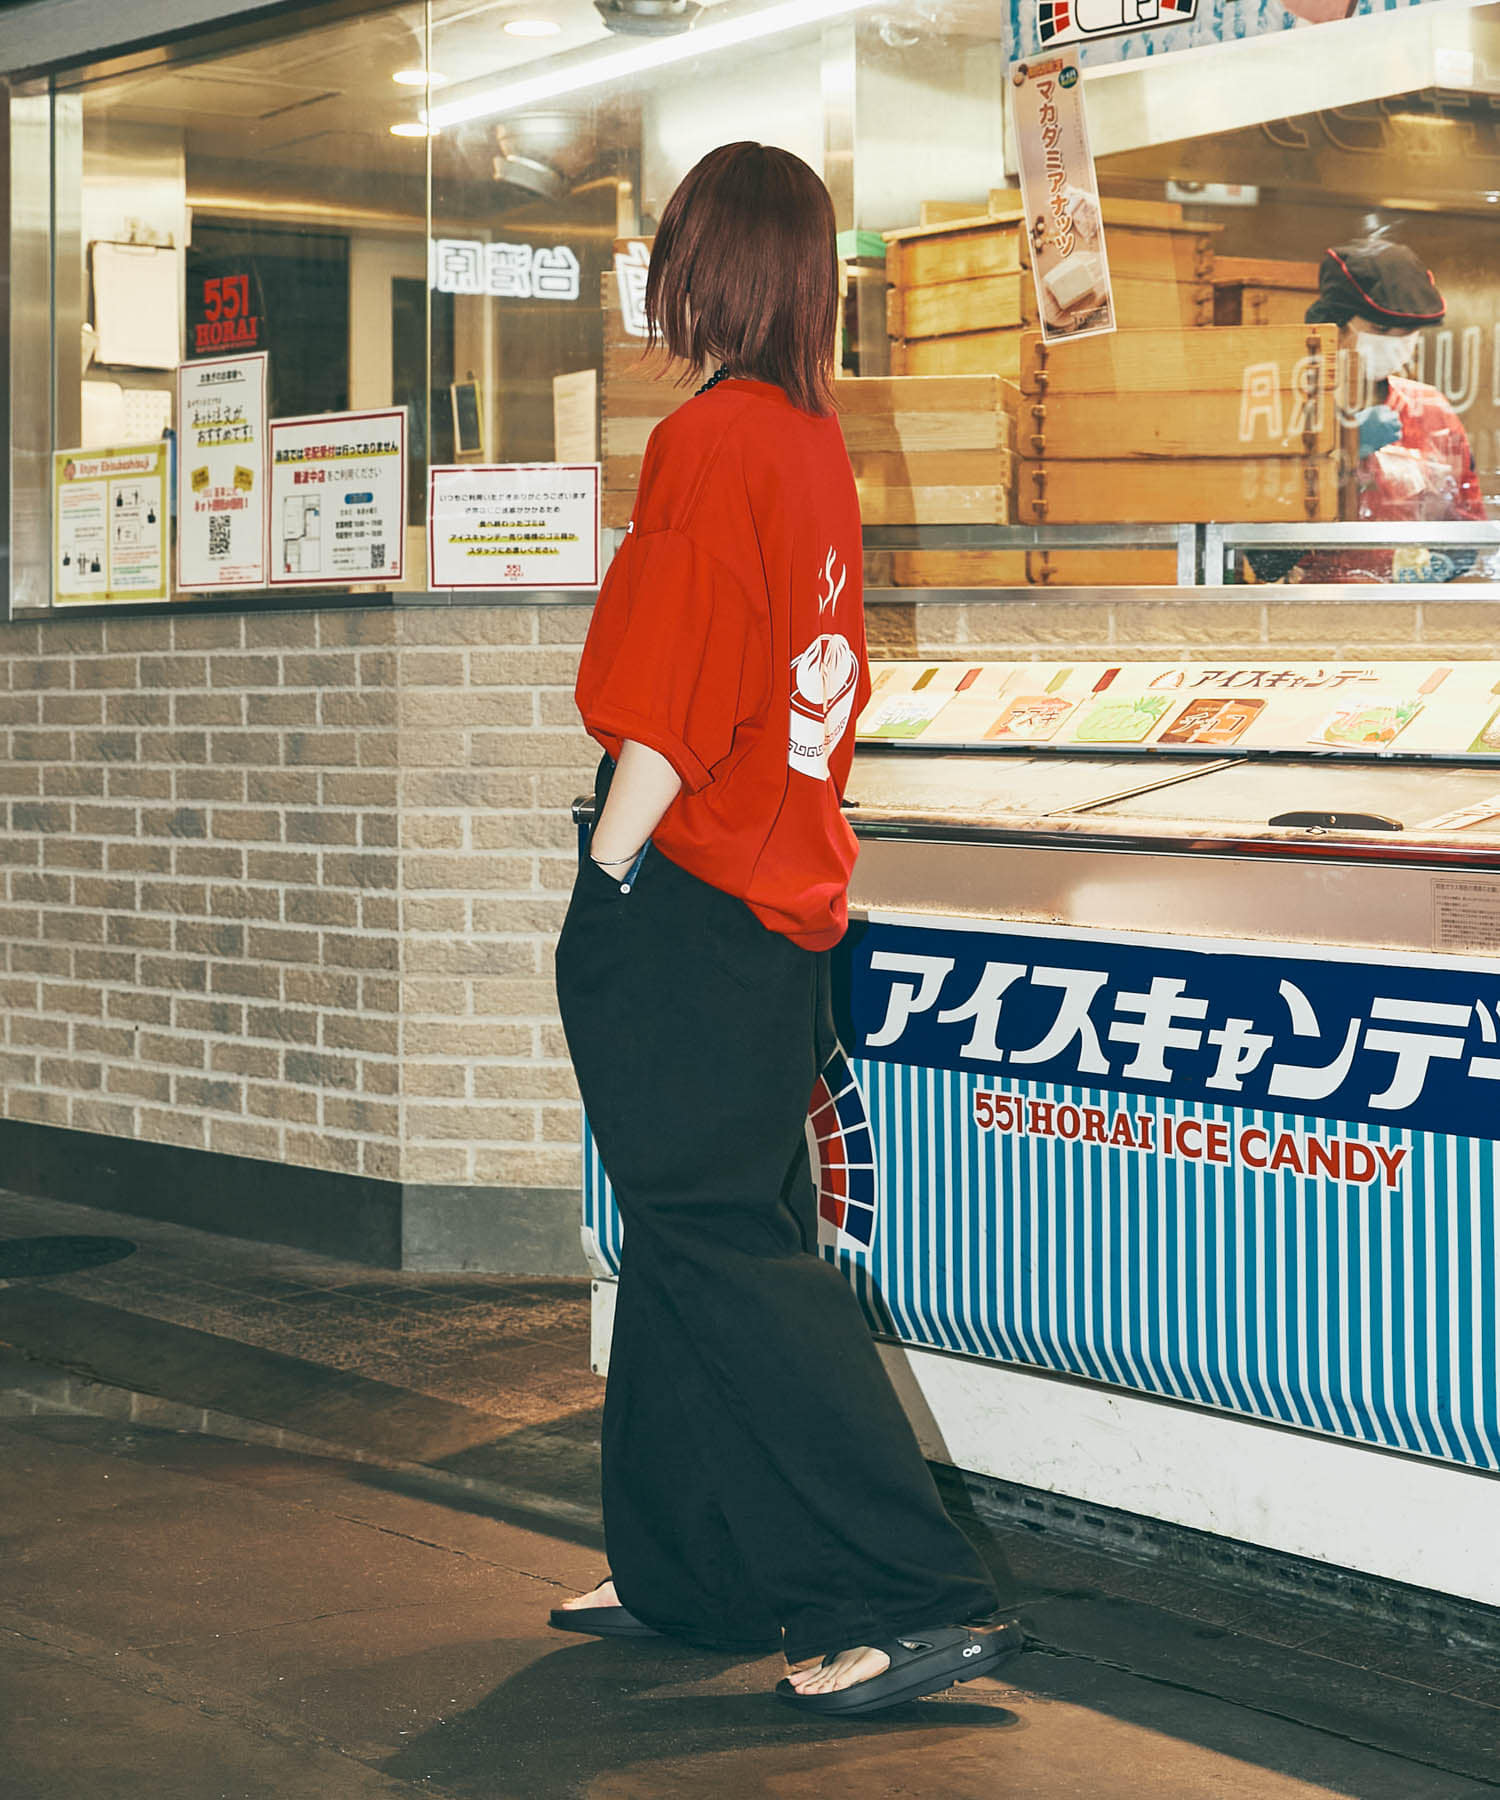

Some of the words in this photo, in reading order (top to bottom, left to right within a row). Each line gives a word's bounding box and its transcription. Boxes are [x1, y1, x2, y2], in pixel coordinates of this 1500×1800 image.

[1036, 80, 1075, 258] マカダミアナッツ
[203, 274, 248, 322] 551
[195, 316, 257, 346] HORAI
[1189, 670, 1379, 688] アイスキャンデー
[1163, 1117, 1229, 1163] ICE
[1239, 1129, 1408, 1188] CANDY
